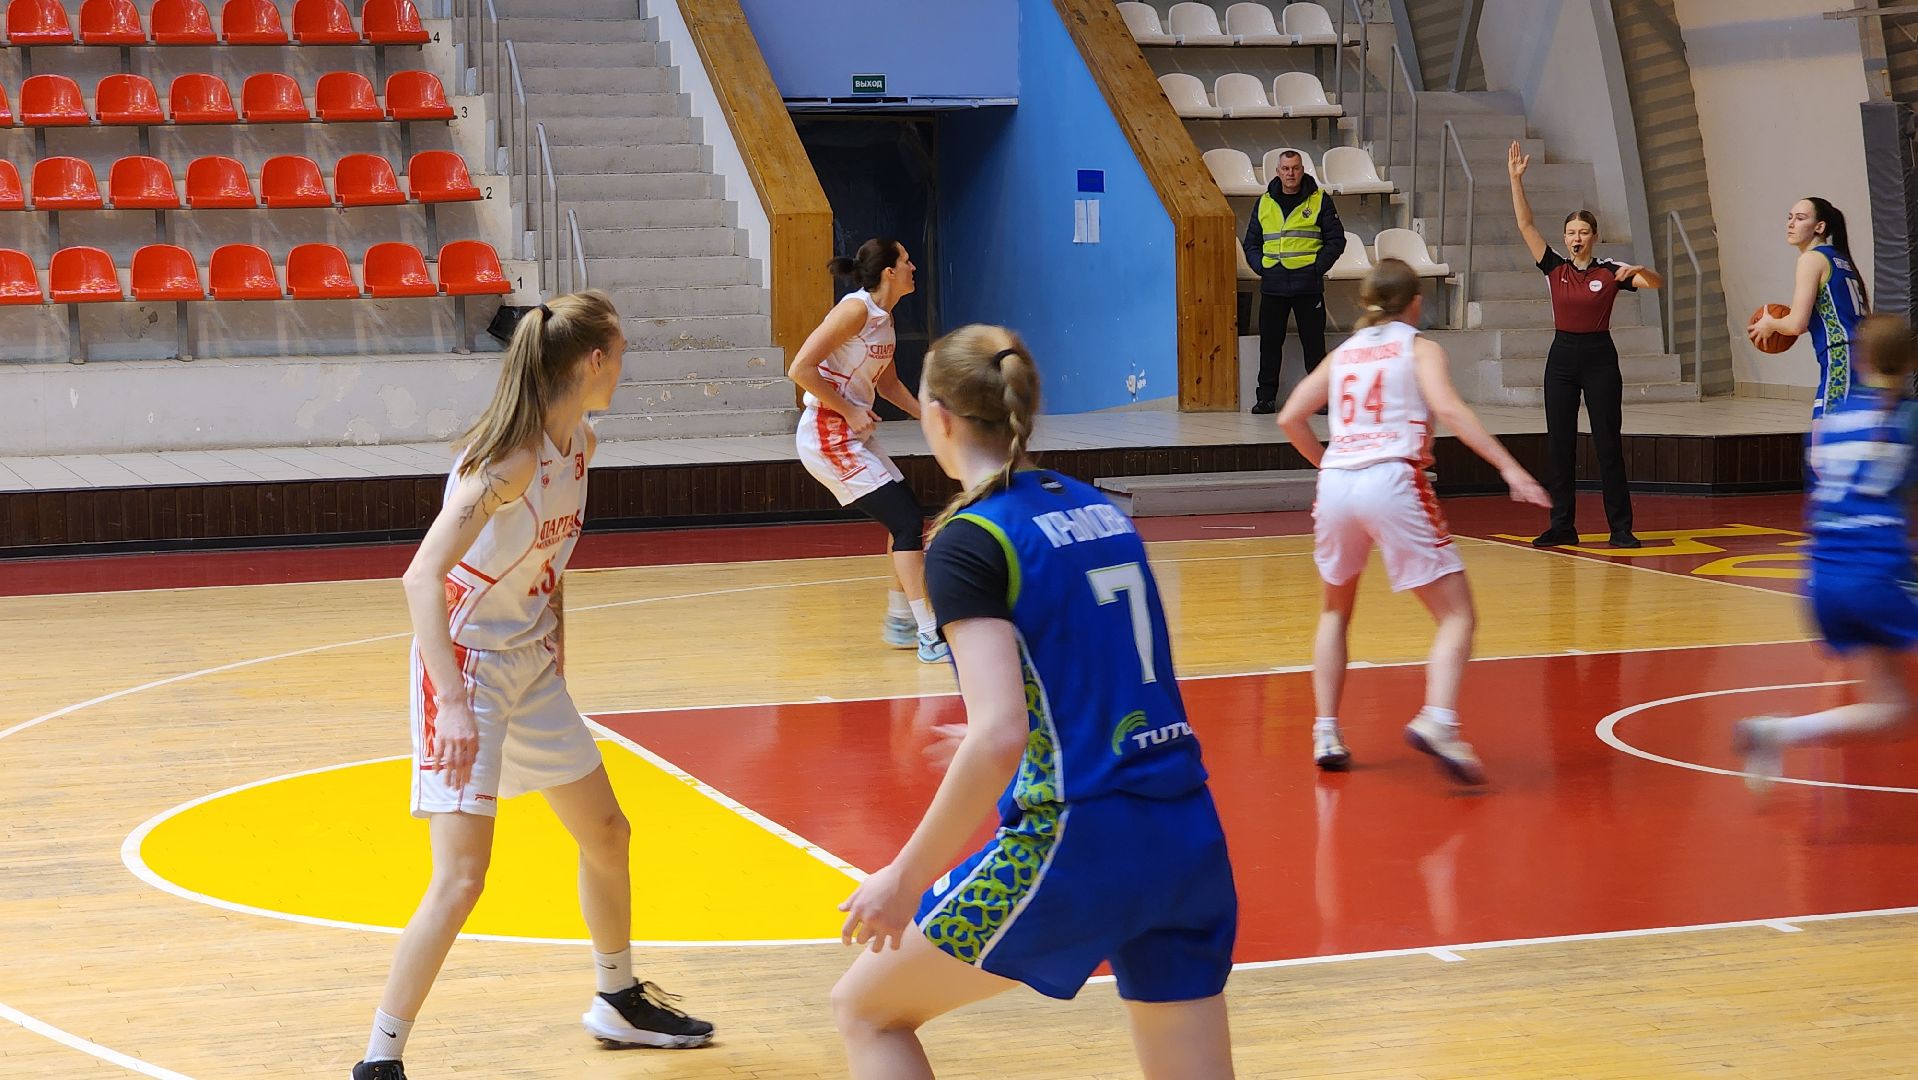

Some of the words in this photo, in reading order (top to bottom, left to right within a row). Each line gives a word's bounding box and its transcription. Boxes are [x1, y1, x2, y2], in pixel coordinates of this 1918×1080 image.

[433, 31, 441, 44] 4
[854, 80, 883, 89] ВЫХОД
[461, 106, 468, 119] 3
[485, 186, 493, 200] 2
[516, 276, 523, 290] 1
[1339, 368, 1384, 426] 64
[1085, 561, 1157, 685] 7
